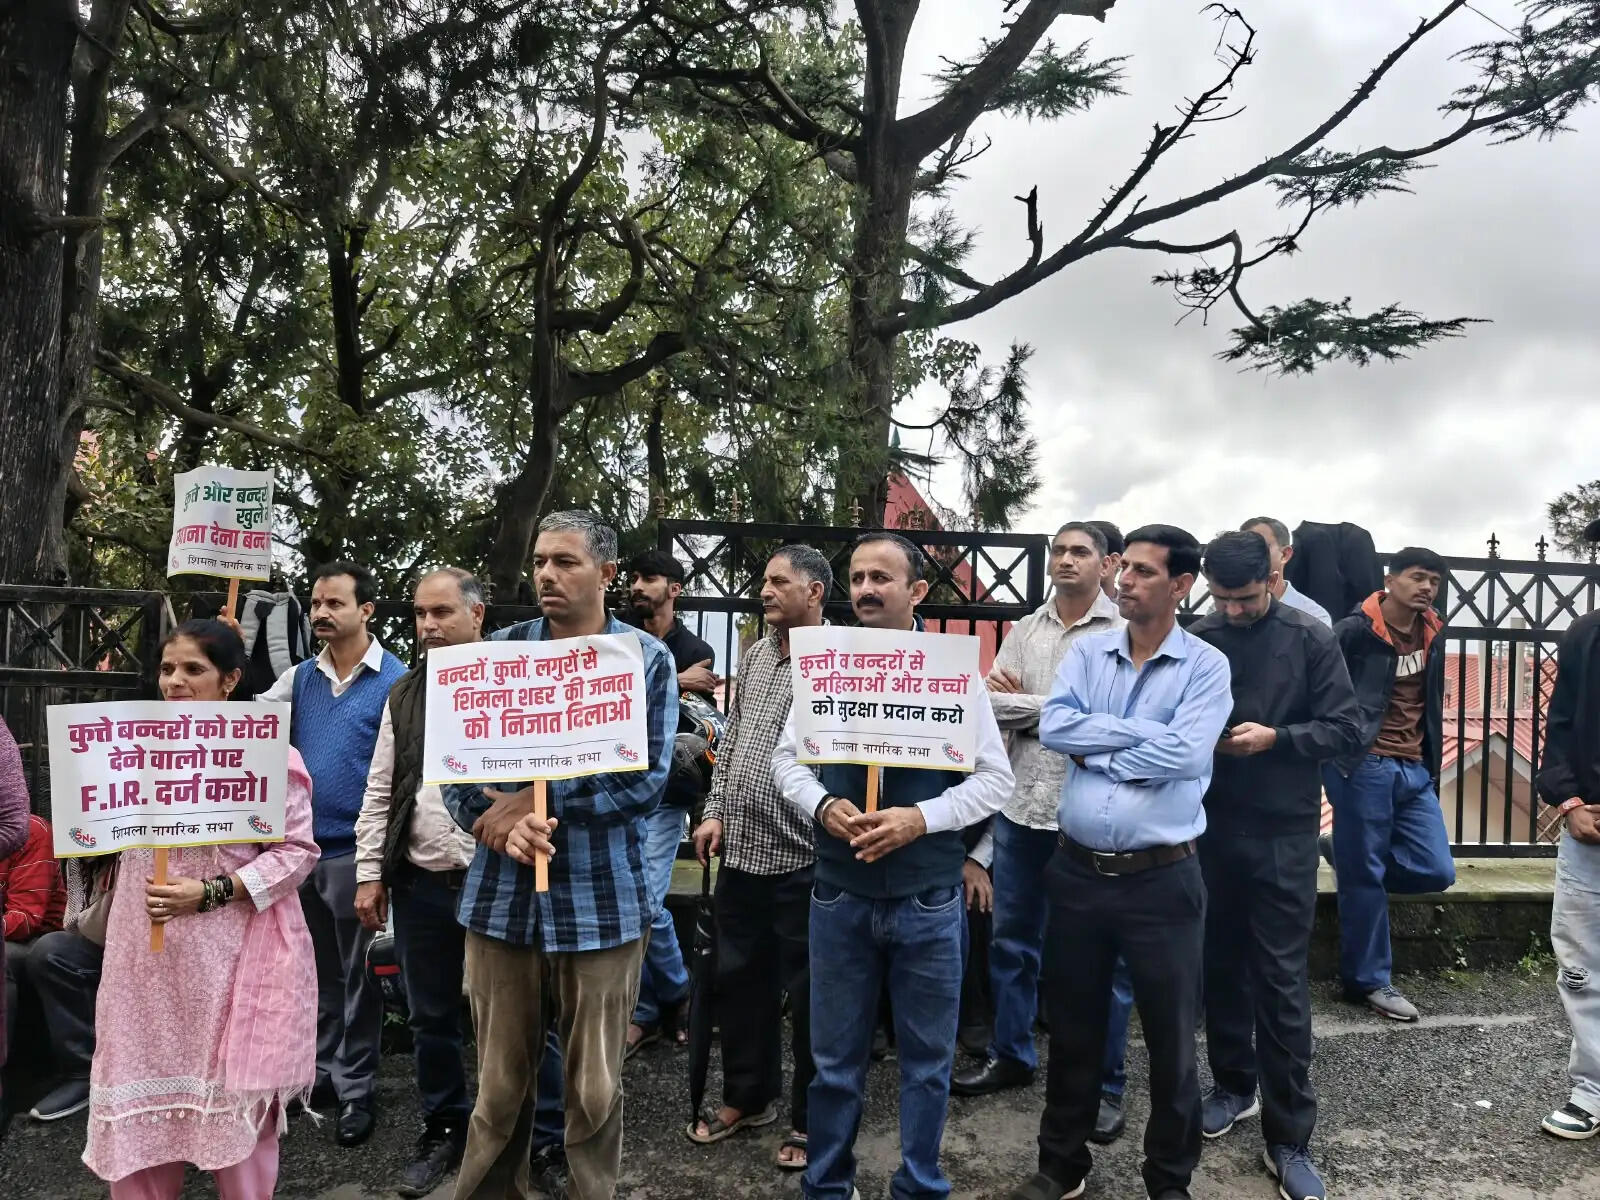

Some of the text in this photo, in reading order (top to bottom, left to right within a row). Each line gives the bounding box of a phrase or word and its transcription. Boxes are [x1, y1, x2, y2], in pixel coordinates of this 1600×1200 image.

[203, 480, 234, 503] और
[236, 503, 264, 529] खुले
[210, 520, 241, 548] देना
[187, 554, 218, 568] शिमला
[219, 560, 254, 571] नागरिक
[534, 649, 579, 681] लगुरों
[581, 646, 598, 670] से
[799, 649, 925, 678] कुत्तों व बन्दरों से
[453, 672, 633, 712] शिमला शहर की जनता
[812, 671, 970, 695] महिलाओं और बच्चों
[463, 693, 632, 740] को निजात दिलाओ
[812, 695, 964, 724] को सुरक्षा प्रदान करो
[68, 714, 280, 753] कुत्ते बन्दरों को रोटी
[108, 744, 244, 772] देने वालो पर
[481, 752, 601, 770] शिमला नागरिक सभा
[832, 739, 931, 757] शिमला नागरिक सभा
[81, 780, 148, 813] F.I.R.
[155, 773, 202, 805] दर्ज
[112, 822, 233, 841] शिमला नागरिक सभा
